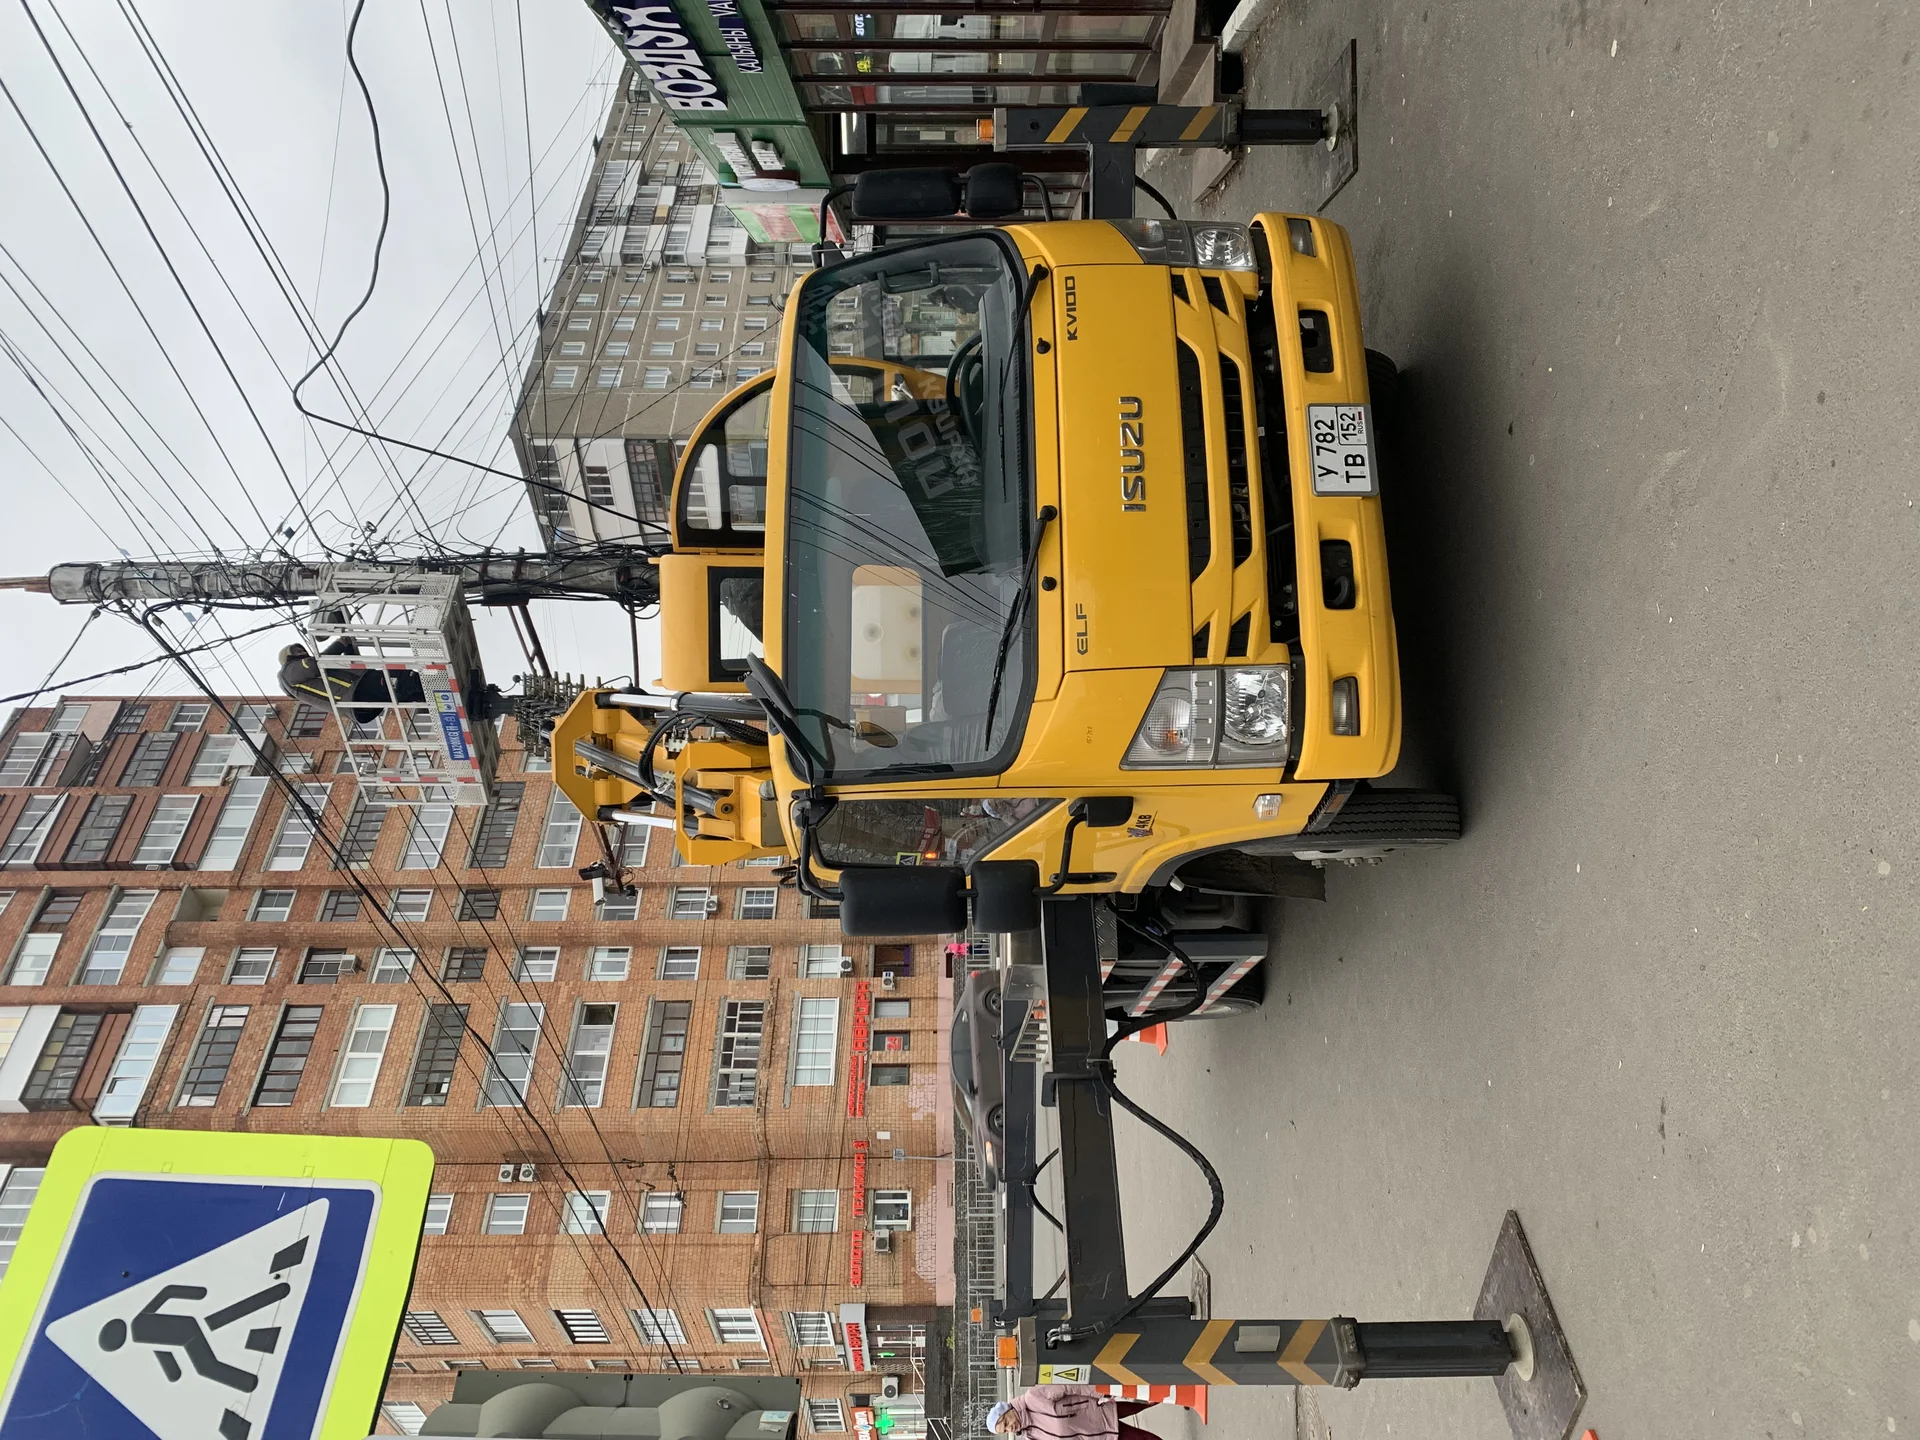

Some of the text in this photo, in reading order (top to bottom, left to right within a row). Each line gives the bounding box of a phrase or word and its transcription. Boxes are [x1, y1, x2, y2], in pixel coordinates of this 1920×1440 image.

[608, 5, 728, 110] ВОЗДУХ
[705, 0, 763, 73] КАЛЬЯНЫ VA
[1064, 276, 1078, 341] KV100
[1118, 396, 1146, 512] ISUZU
[1314, 419, 1338, 478] У 782
[1340, 413, 1357, 441] 152
[1344, 454, 1366, 484] ТВ
[1075, 602, 1088, 656] ELF
[851, 981, 871, 1051] АВРОРА
[852, 1153, 866, 1218] ТЕХНИКА
[850, 1230, 863, 1288] ЗОЛОТО
[846, 1323, 862, 1348] АВРОРА
